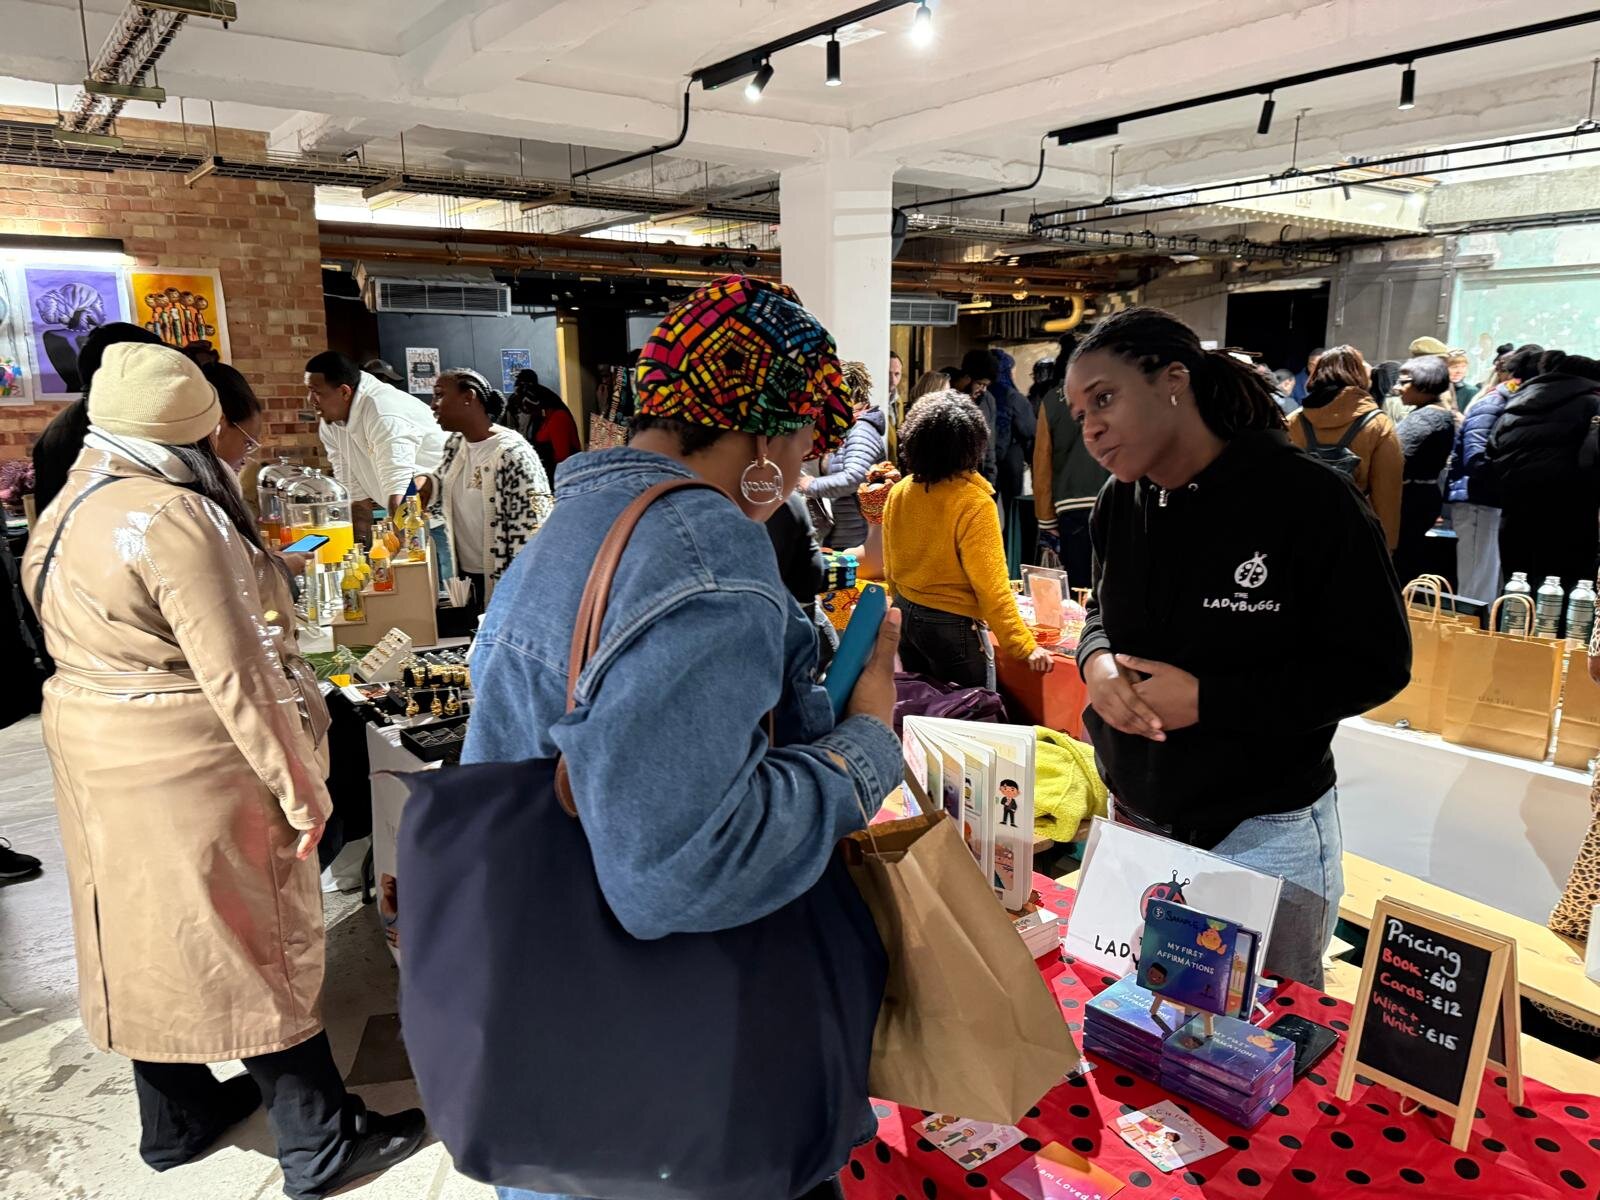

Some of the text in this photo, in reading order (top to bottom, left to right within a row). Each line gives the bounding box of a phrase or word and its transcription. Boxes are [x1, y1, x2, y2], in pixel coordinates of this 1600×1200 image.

[1203, 598, 1280, 612] LADYBUGGS
[1167, 942, 1204, 958] MY FIRST
[1388, 919, 1461, 978] Pricing
[1156, 949, 1215, 974] AFFIRMATIONS
[1040, 1168, 1054, 1180] am
[1055, 1177, 1089, 1200] Loved
